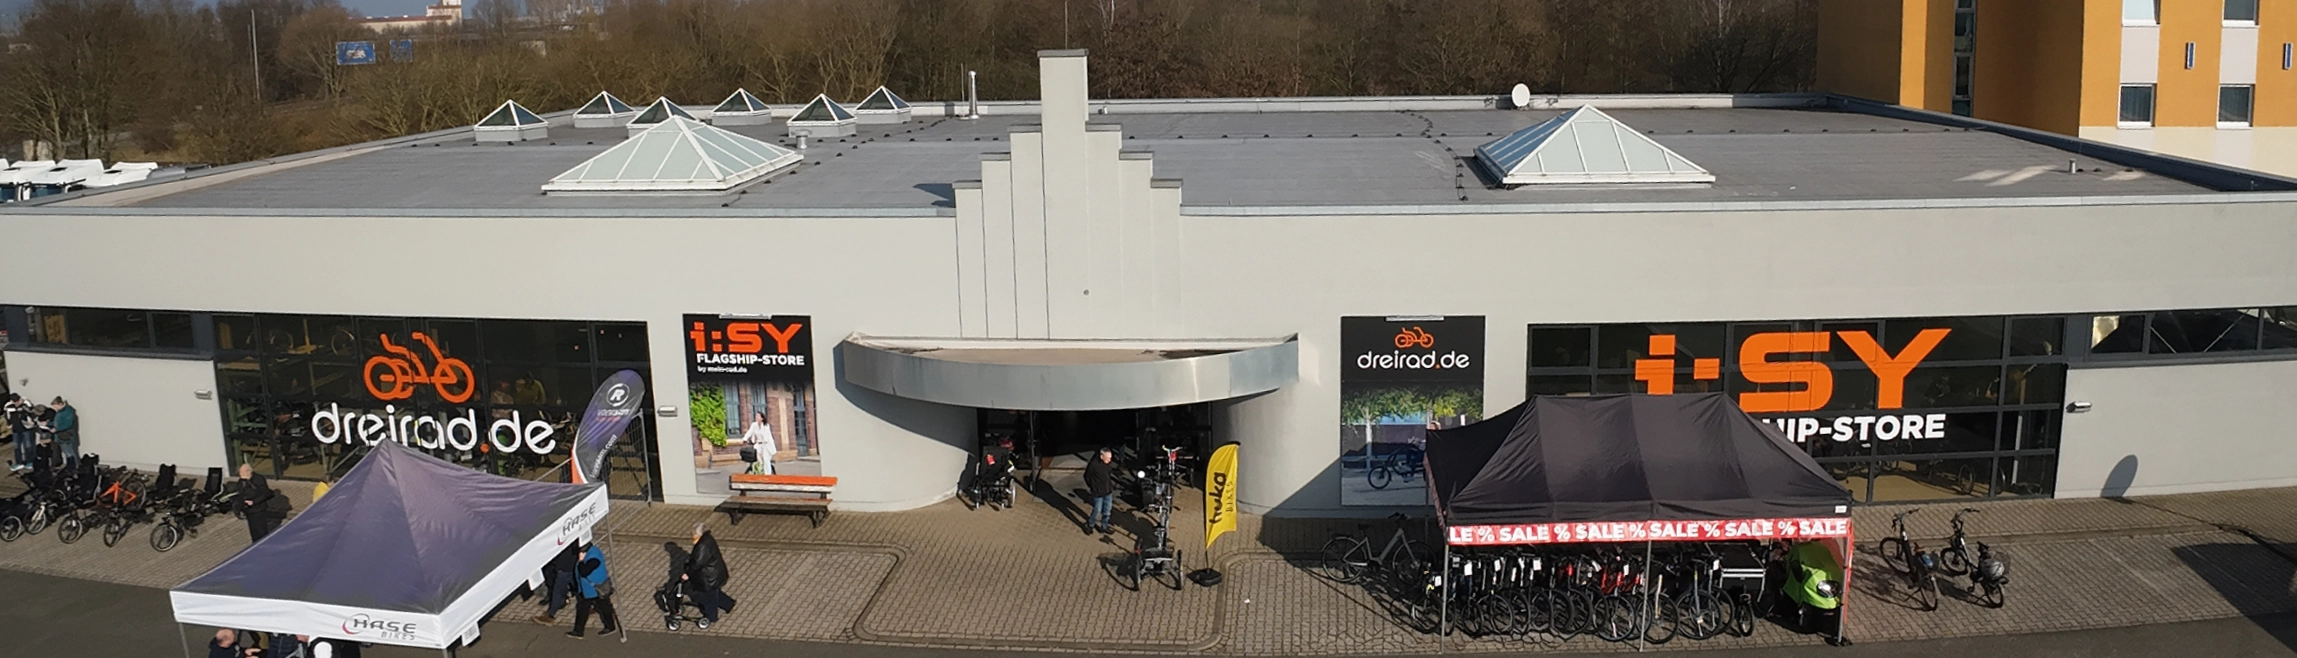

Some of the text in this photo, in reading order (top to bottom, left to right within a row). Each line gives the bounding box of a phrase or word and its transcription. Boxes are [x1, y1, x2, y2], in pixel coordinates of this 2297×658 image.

[690, 321, 803, 353] i:SY
[696, 353, 805, 366] FLAGSHIP-STORE
[1357, 350, 1470, 369] dreirad.de
[311, 402, 557, 455] dreirad.de
[1762, 414, 1947, 443] IP-STORE
[1208, 472, 1227, 524] huka
[562, 502, 596, 536] HASE
[1478, 528, 1496, 543] %
[1499, 526, 1550, 542] SALE
[1553, 526, 1571, 541] %
[1575, 524, 1625, 540] SALE
[1629, 523, 1647, 539] %
[1650, 522, 1699, 538] SALE
[1703, 522, 1721, 538] %
[1724, 521, 1774, 537] SALE
[1777, 520, 1796, 536] %
[1799, 520, 1847, 535] SALE
[353, 618, 417, 634] HASE
